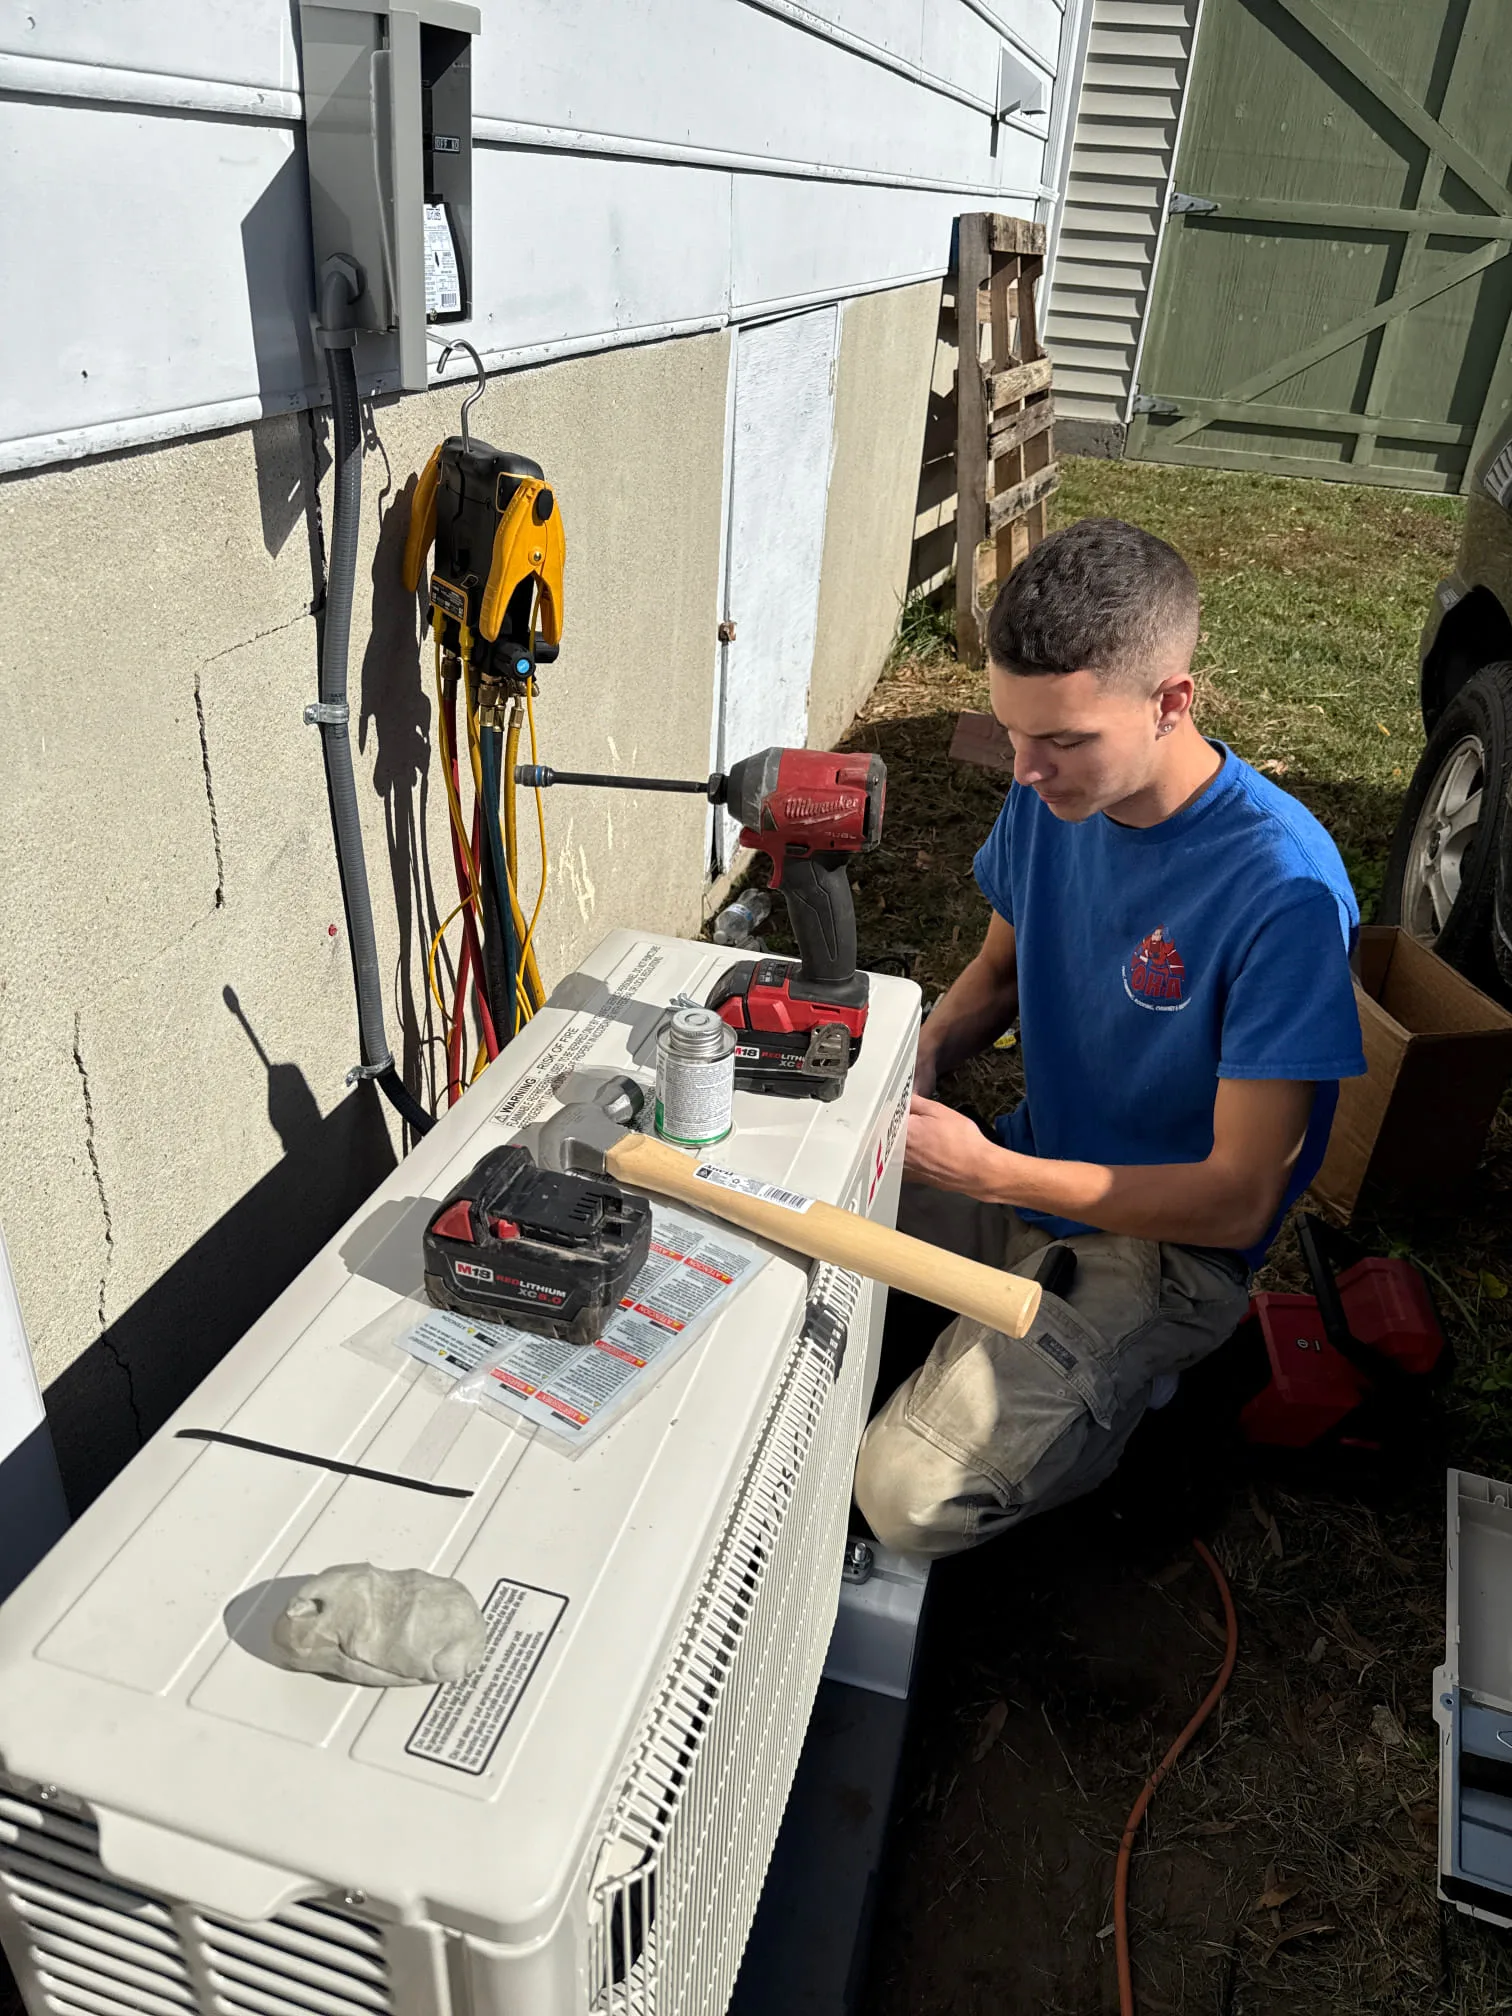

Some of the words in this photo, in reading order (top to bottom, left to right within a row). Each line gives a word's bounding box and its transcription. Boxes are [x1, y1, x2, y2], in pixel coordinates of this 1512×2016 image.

[785, 795, 859, 818] Milwaukee
[500, 1078, 536, 1112] WARNING
[536, 1053, 557, 1070] RISK
[551, 1042, 564, 1053] OF
[559, 1027, 579, 1042] FIRE
[457, 1263, 491, 1280] M18
[496, 1273, 567, 1298] REDLITHIUM
[517, 1288, 538, 1299] XC
[538, 1293, 563, 1306] 5.0
[448, 1749, 460, 1760] Do
[455, 1738, 465, 1749] not
[479, 1681, 497, 1706] anything
[495, 1663, 505, 1672] the
[502, 1642, 516, 1663] outdoor
